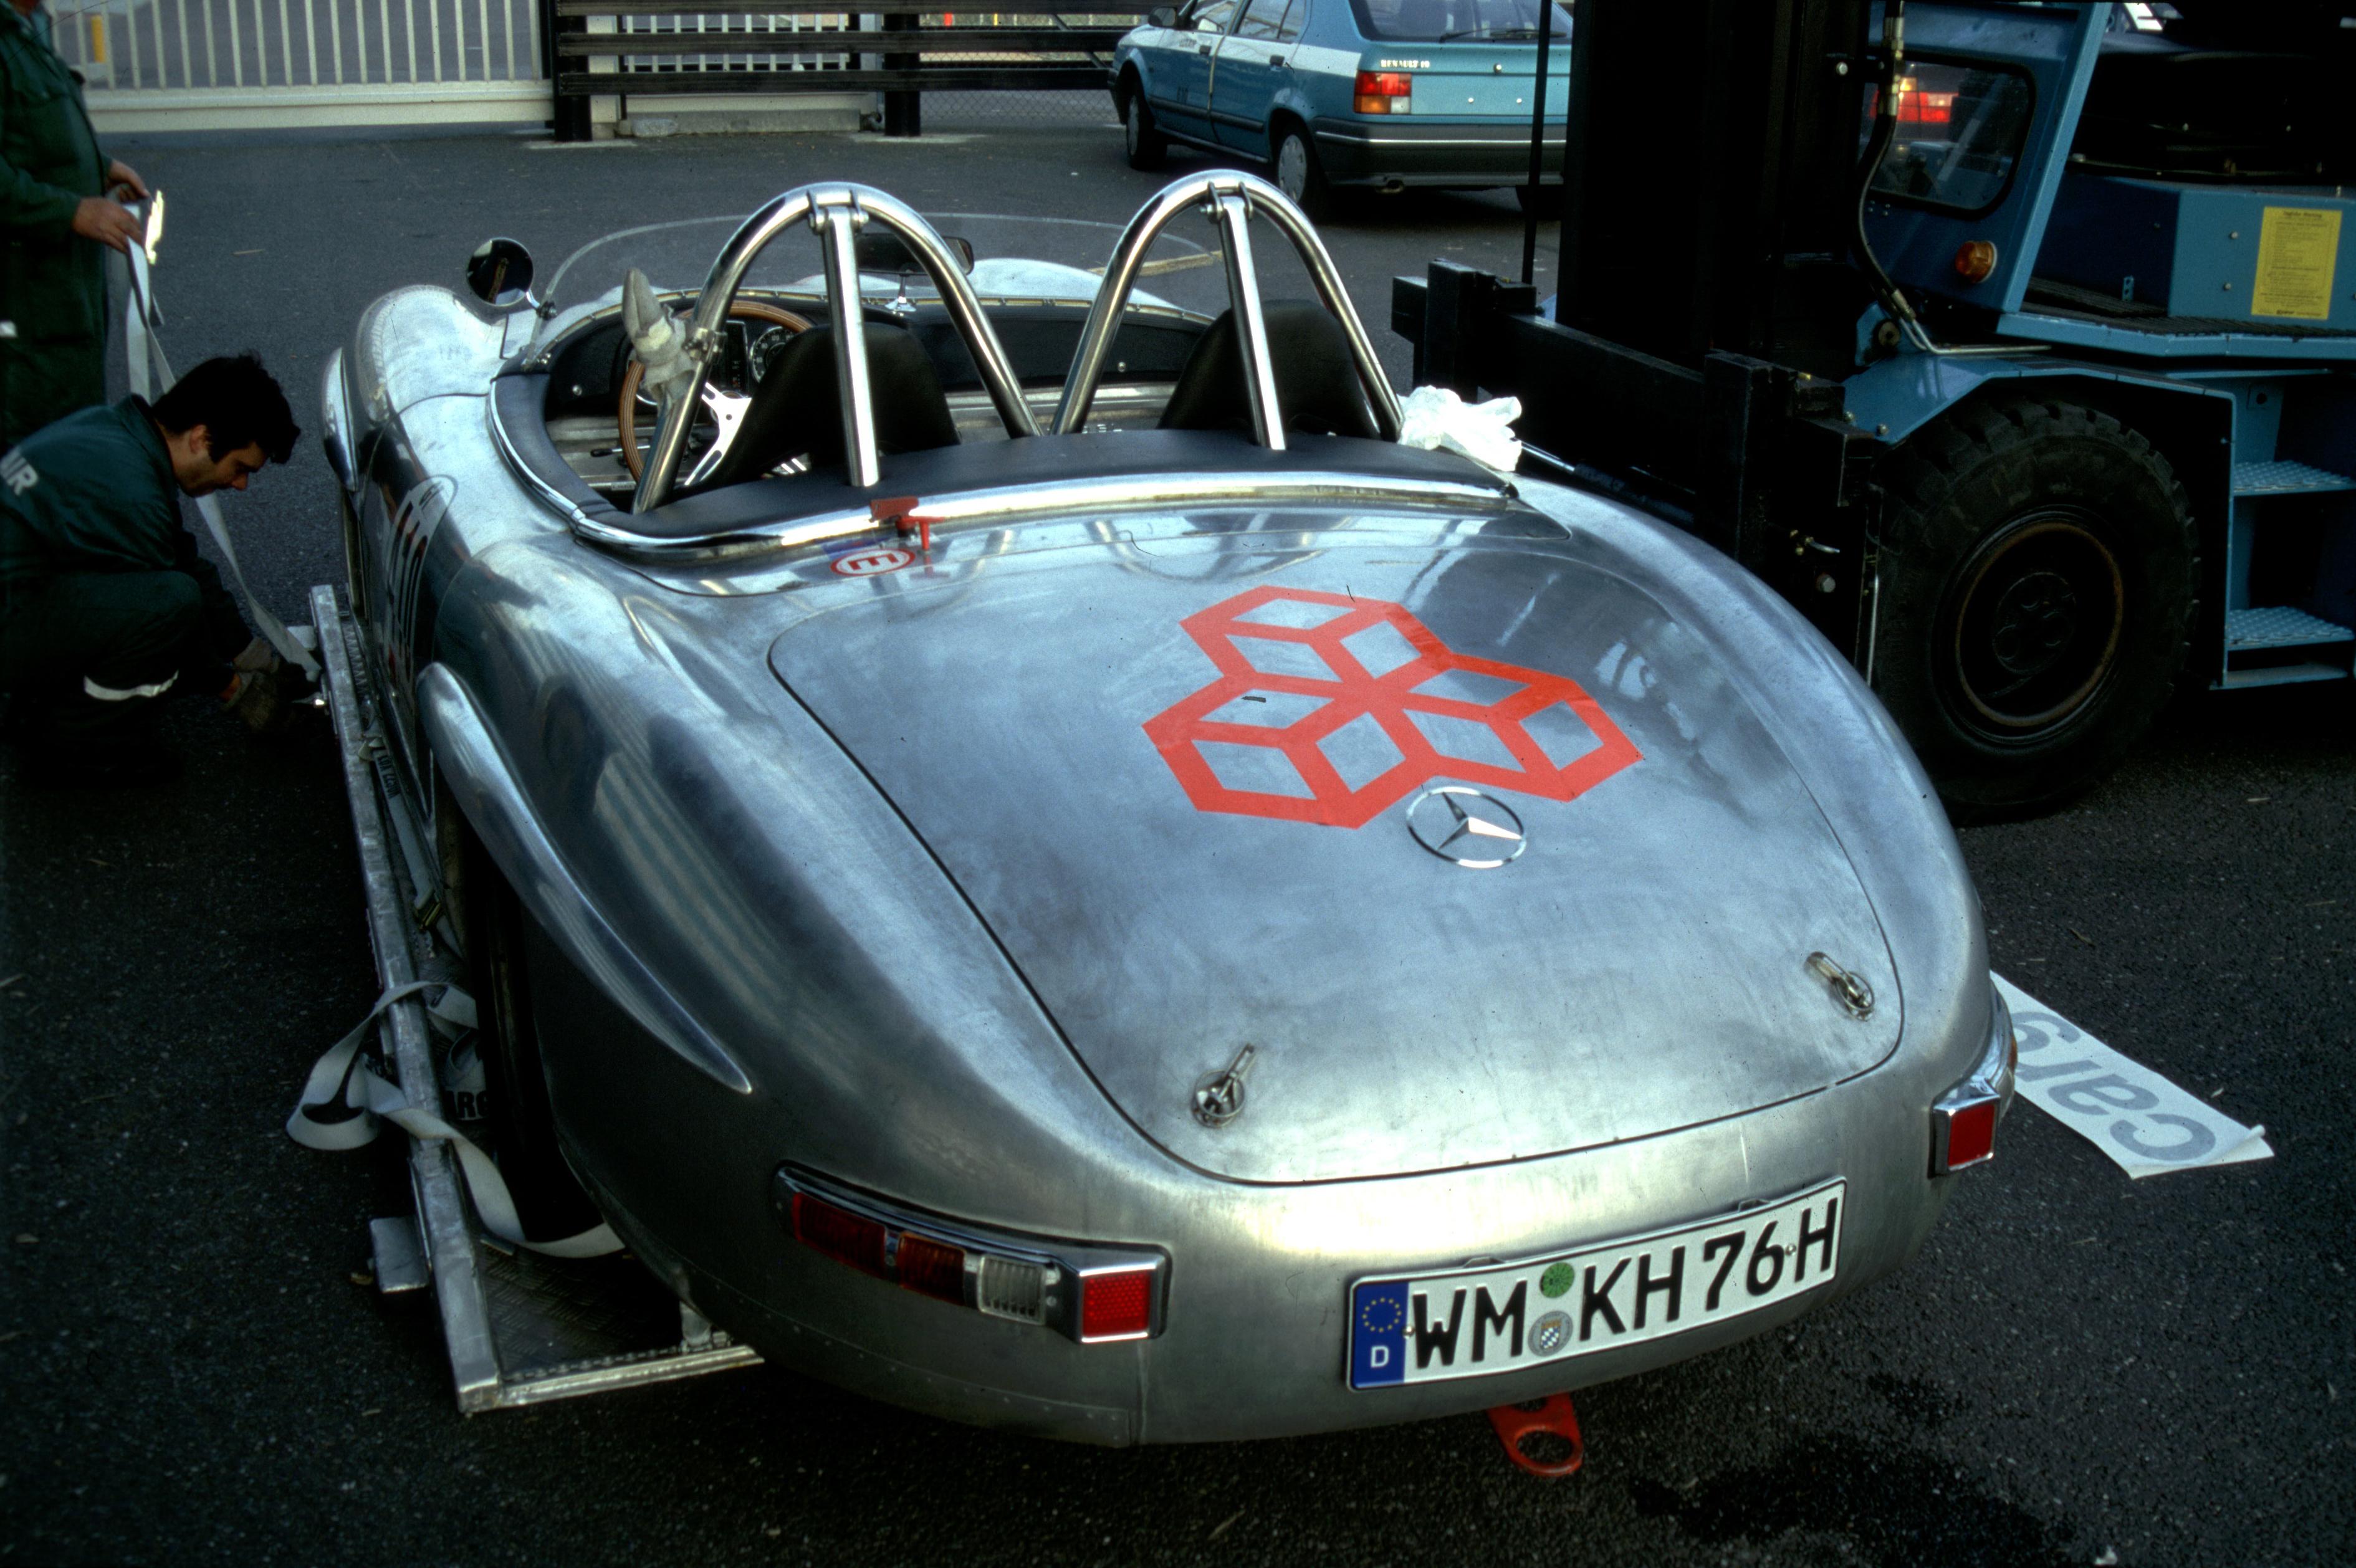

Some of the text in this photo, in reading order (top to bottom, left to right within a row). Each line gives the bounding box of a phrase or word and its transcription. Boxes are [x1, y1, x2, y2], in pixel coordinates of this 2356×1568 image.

[1412, 1281, 1528, 1370] WM
[1578, 1246, 1687, 1342] KH
[1702, 1197, 1839, 1312] 76H
[1371, 1346, 1390, 1368] D
